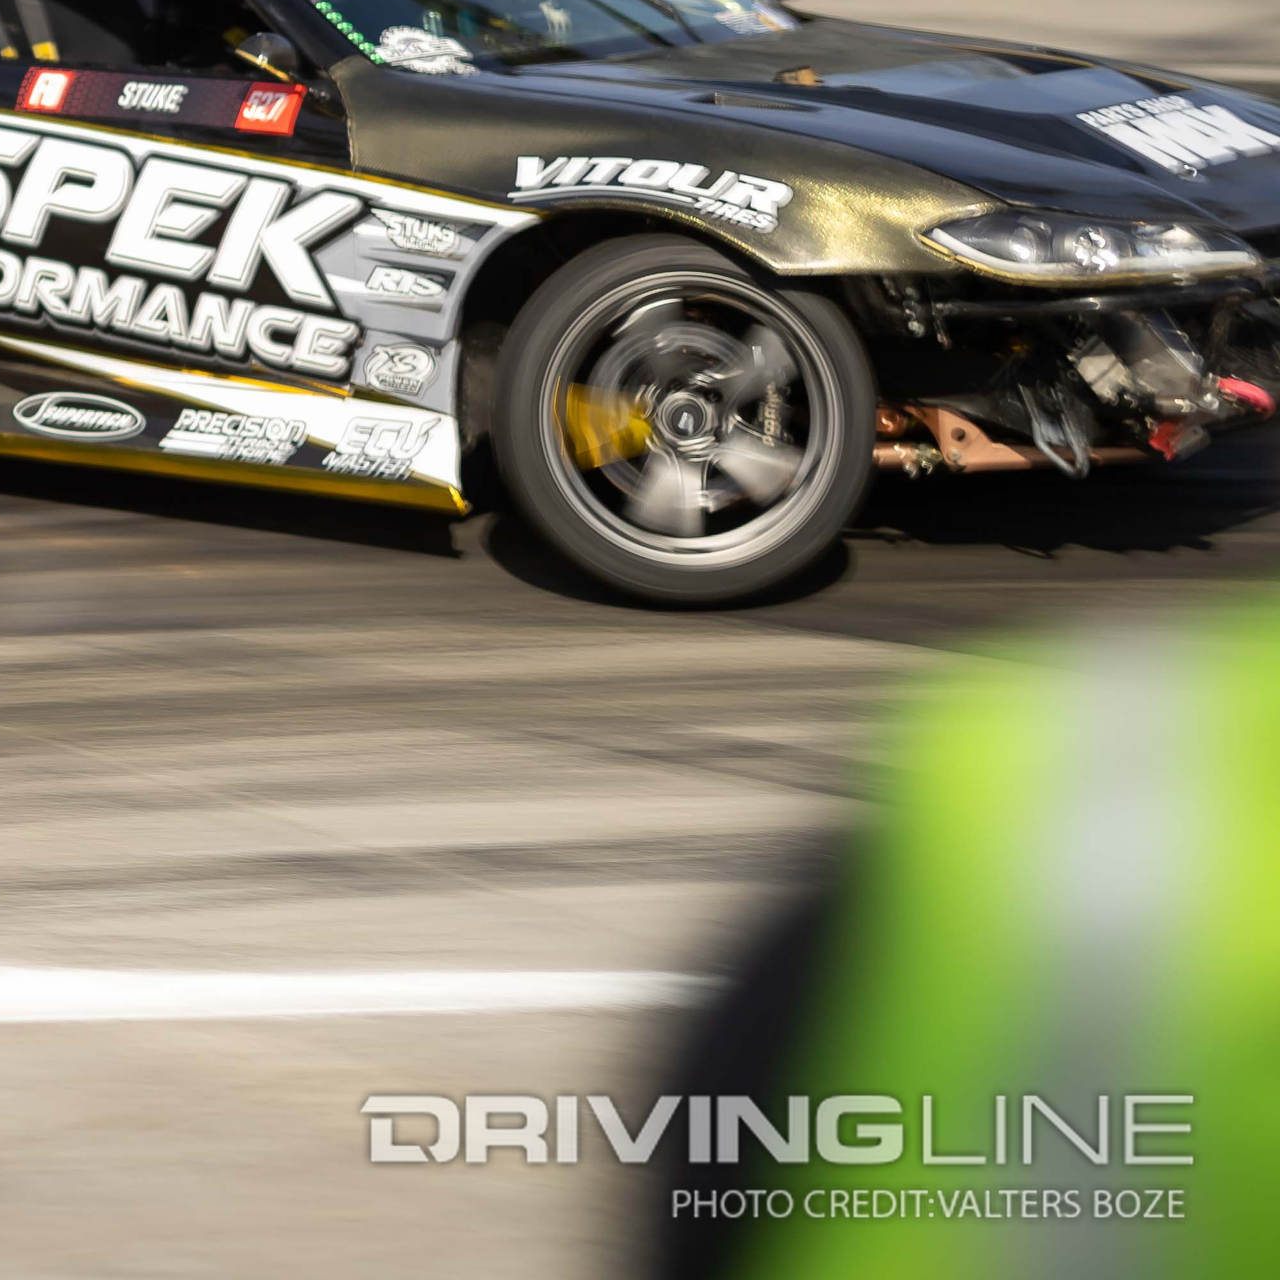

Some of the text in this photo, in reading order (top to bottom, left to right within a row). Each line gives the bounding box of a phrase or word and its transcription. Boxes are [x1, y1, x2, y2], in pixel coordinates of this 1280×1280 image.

[118, 81, 188, 114] STUKE
[241, 91, 289, 122] 527
[1076, 95, 1192, 127] PARTS SHOP
[514, 156, 794, 218] VITOUR
[693, 196, 779, 234] TIRES
[174, 408, 307, 445] PRECISION
[336, 416, 442, 459] ECU
[322, 451, 415, 480] MASTER
